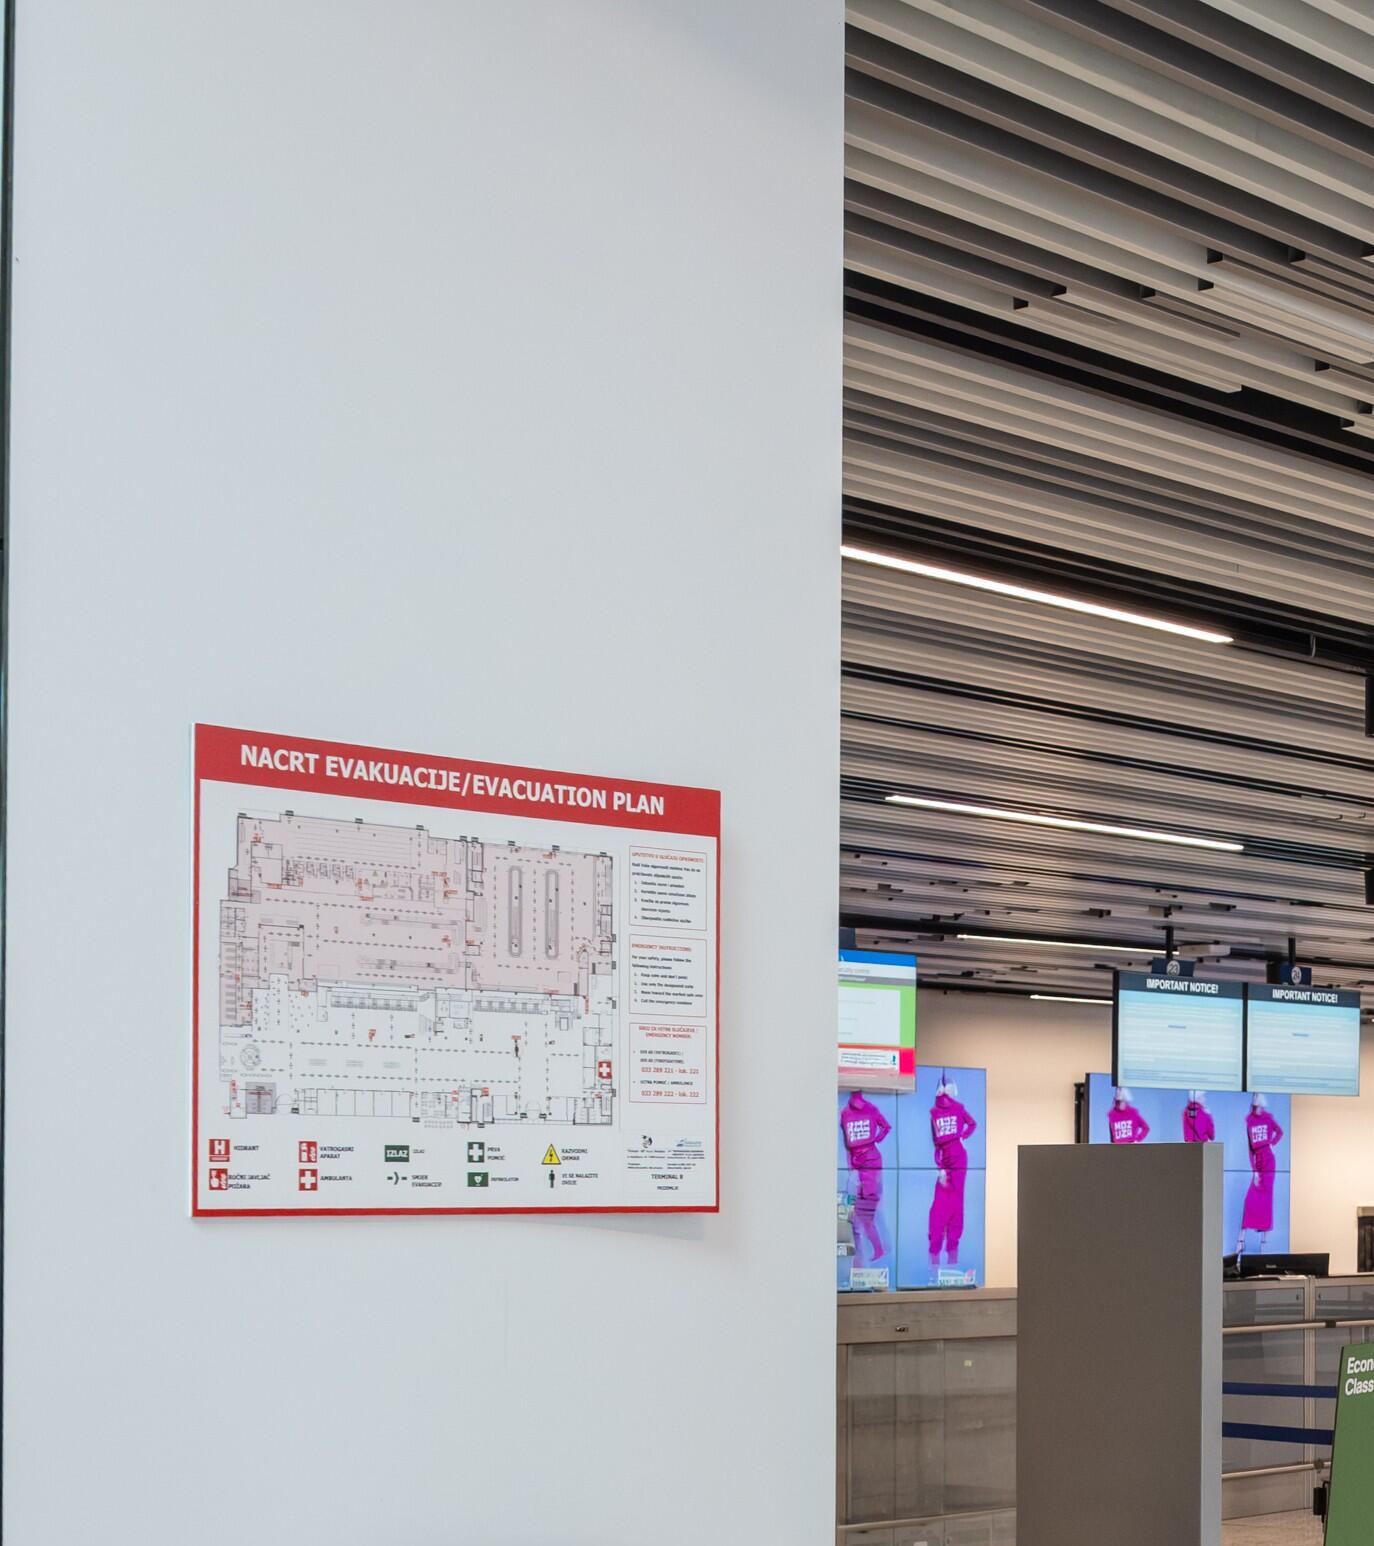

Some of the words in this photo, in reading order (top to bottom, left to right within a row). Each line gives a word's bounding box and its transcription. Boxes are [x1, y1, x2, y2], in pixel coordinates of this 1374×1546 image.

[240, 744, 320, 775] NACRT
[325, 755, 607, 810] EVAKUACIJE/EVACUATION
[613, 791, 665, 816] PLAN
[1146, 978, 1188, 992] IMPORTANT
[1189, 981, 1219, 994] NOTICE!
[1272, 988, 1311, 1002] IMPORTANT
[1311, 992, 1338, 1004] NOTICE!
[386, 1149, 408, 1158] IZLAZ
[1345, 1378, 1374, 1396] Class
